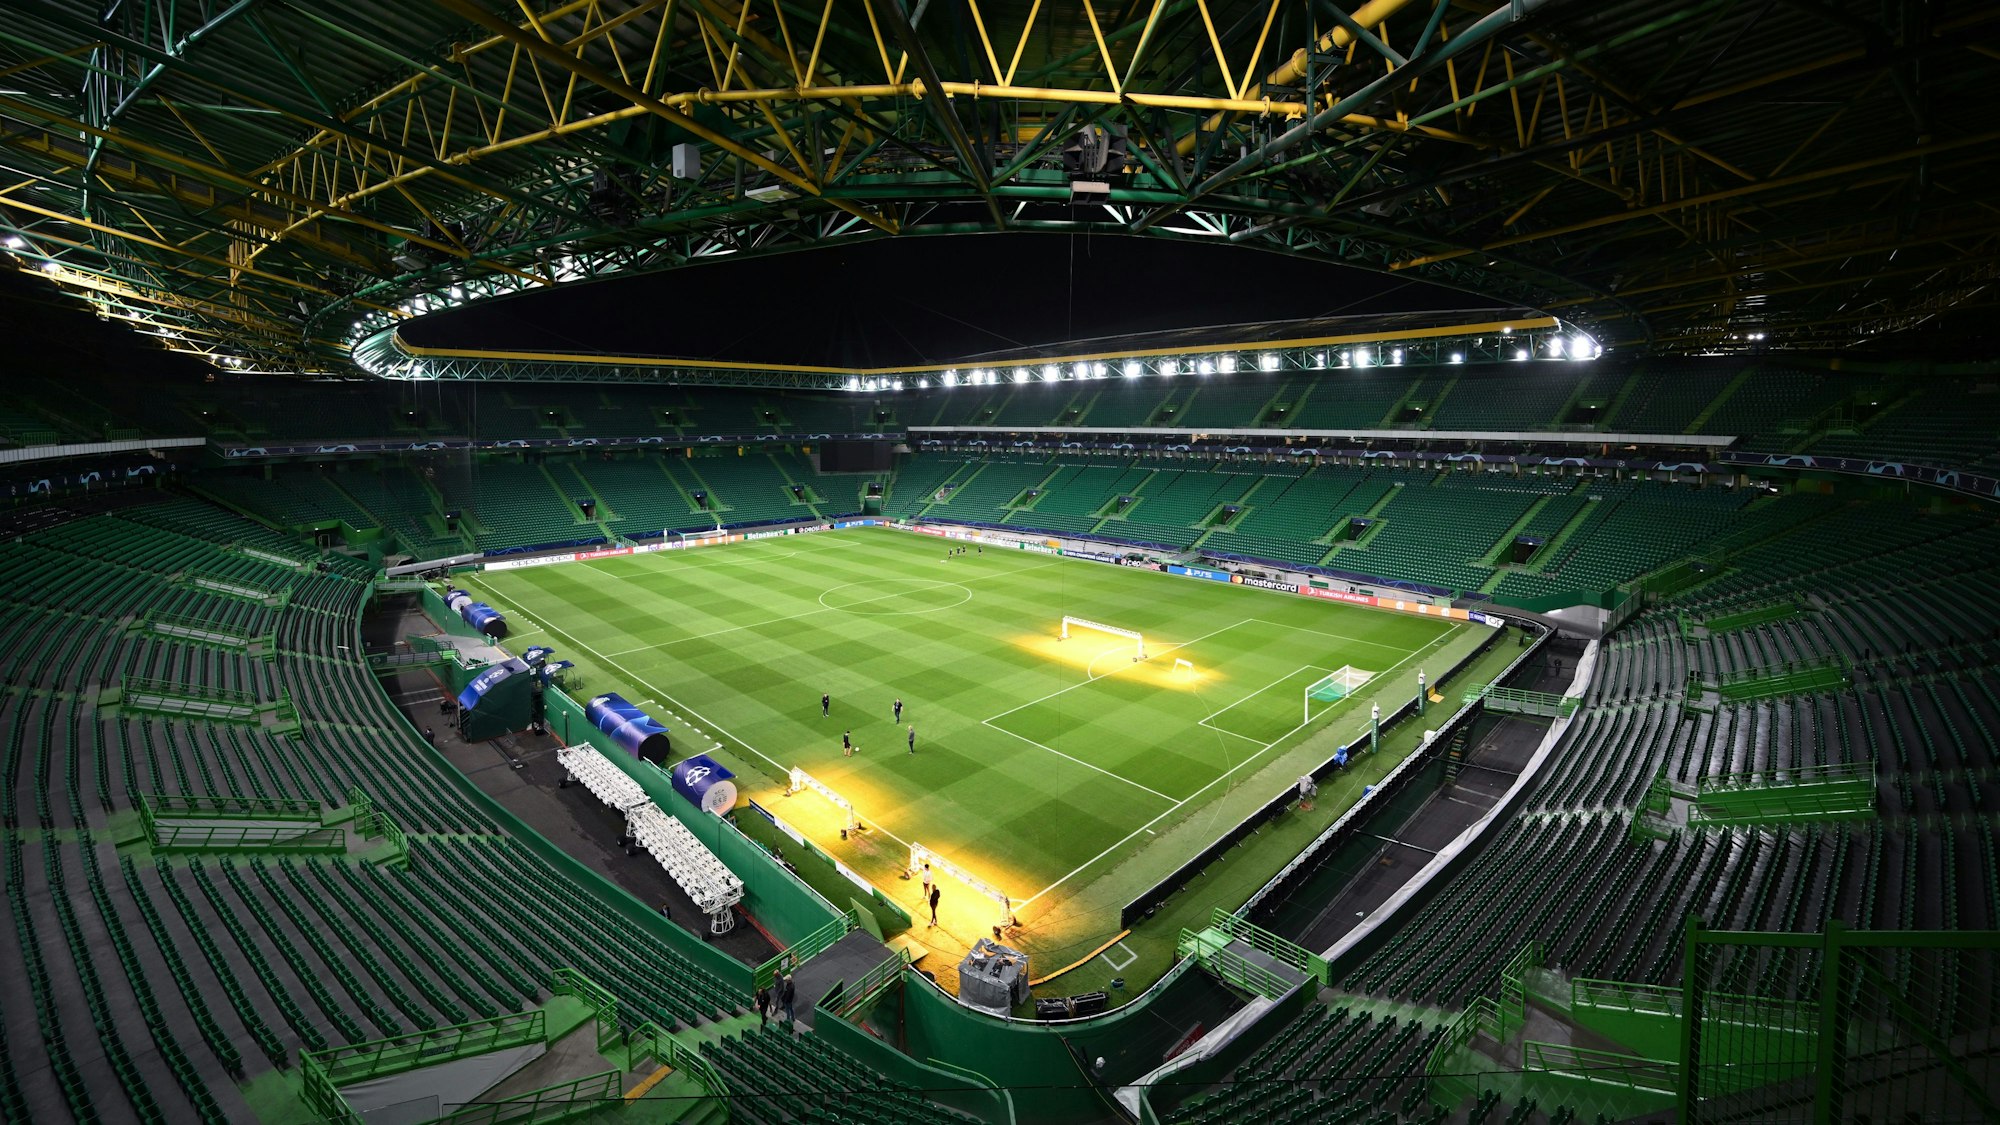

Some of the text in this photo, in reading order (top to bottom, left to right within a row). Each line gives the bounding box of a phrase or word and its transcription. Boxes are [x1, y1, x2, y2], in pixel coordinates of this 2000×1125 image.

[748, 531, 779, 539] Heineken
[1024, 542, 1052, 555] Heineken
[511, 554, 572, 567] oppo oppo
[1193, 569, 1212, 578] PS5
[1244, 577, 1297, 592] mastercard
[1319, 590, 1369, 603] TURKISH AIRLINES
